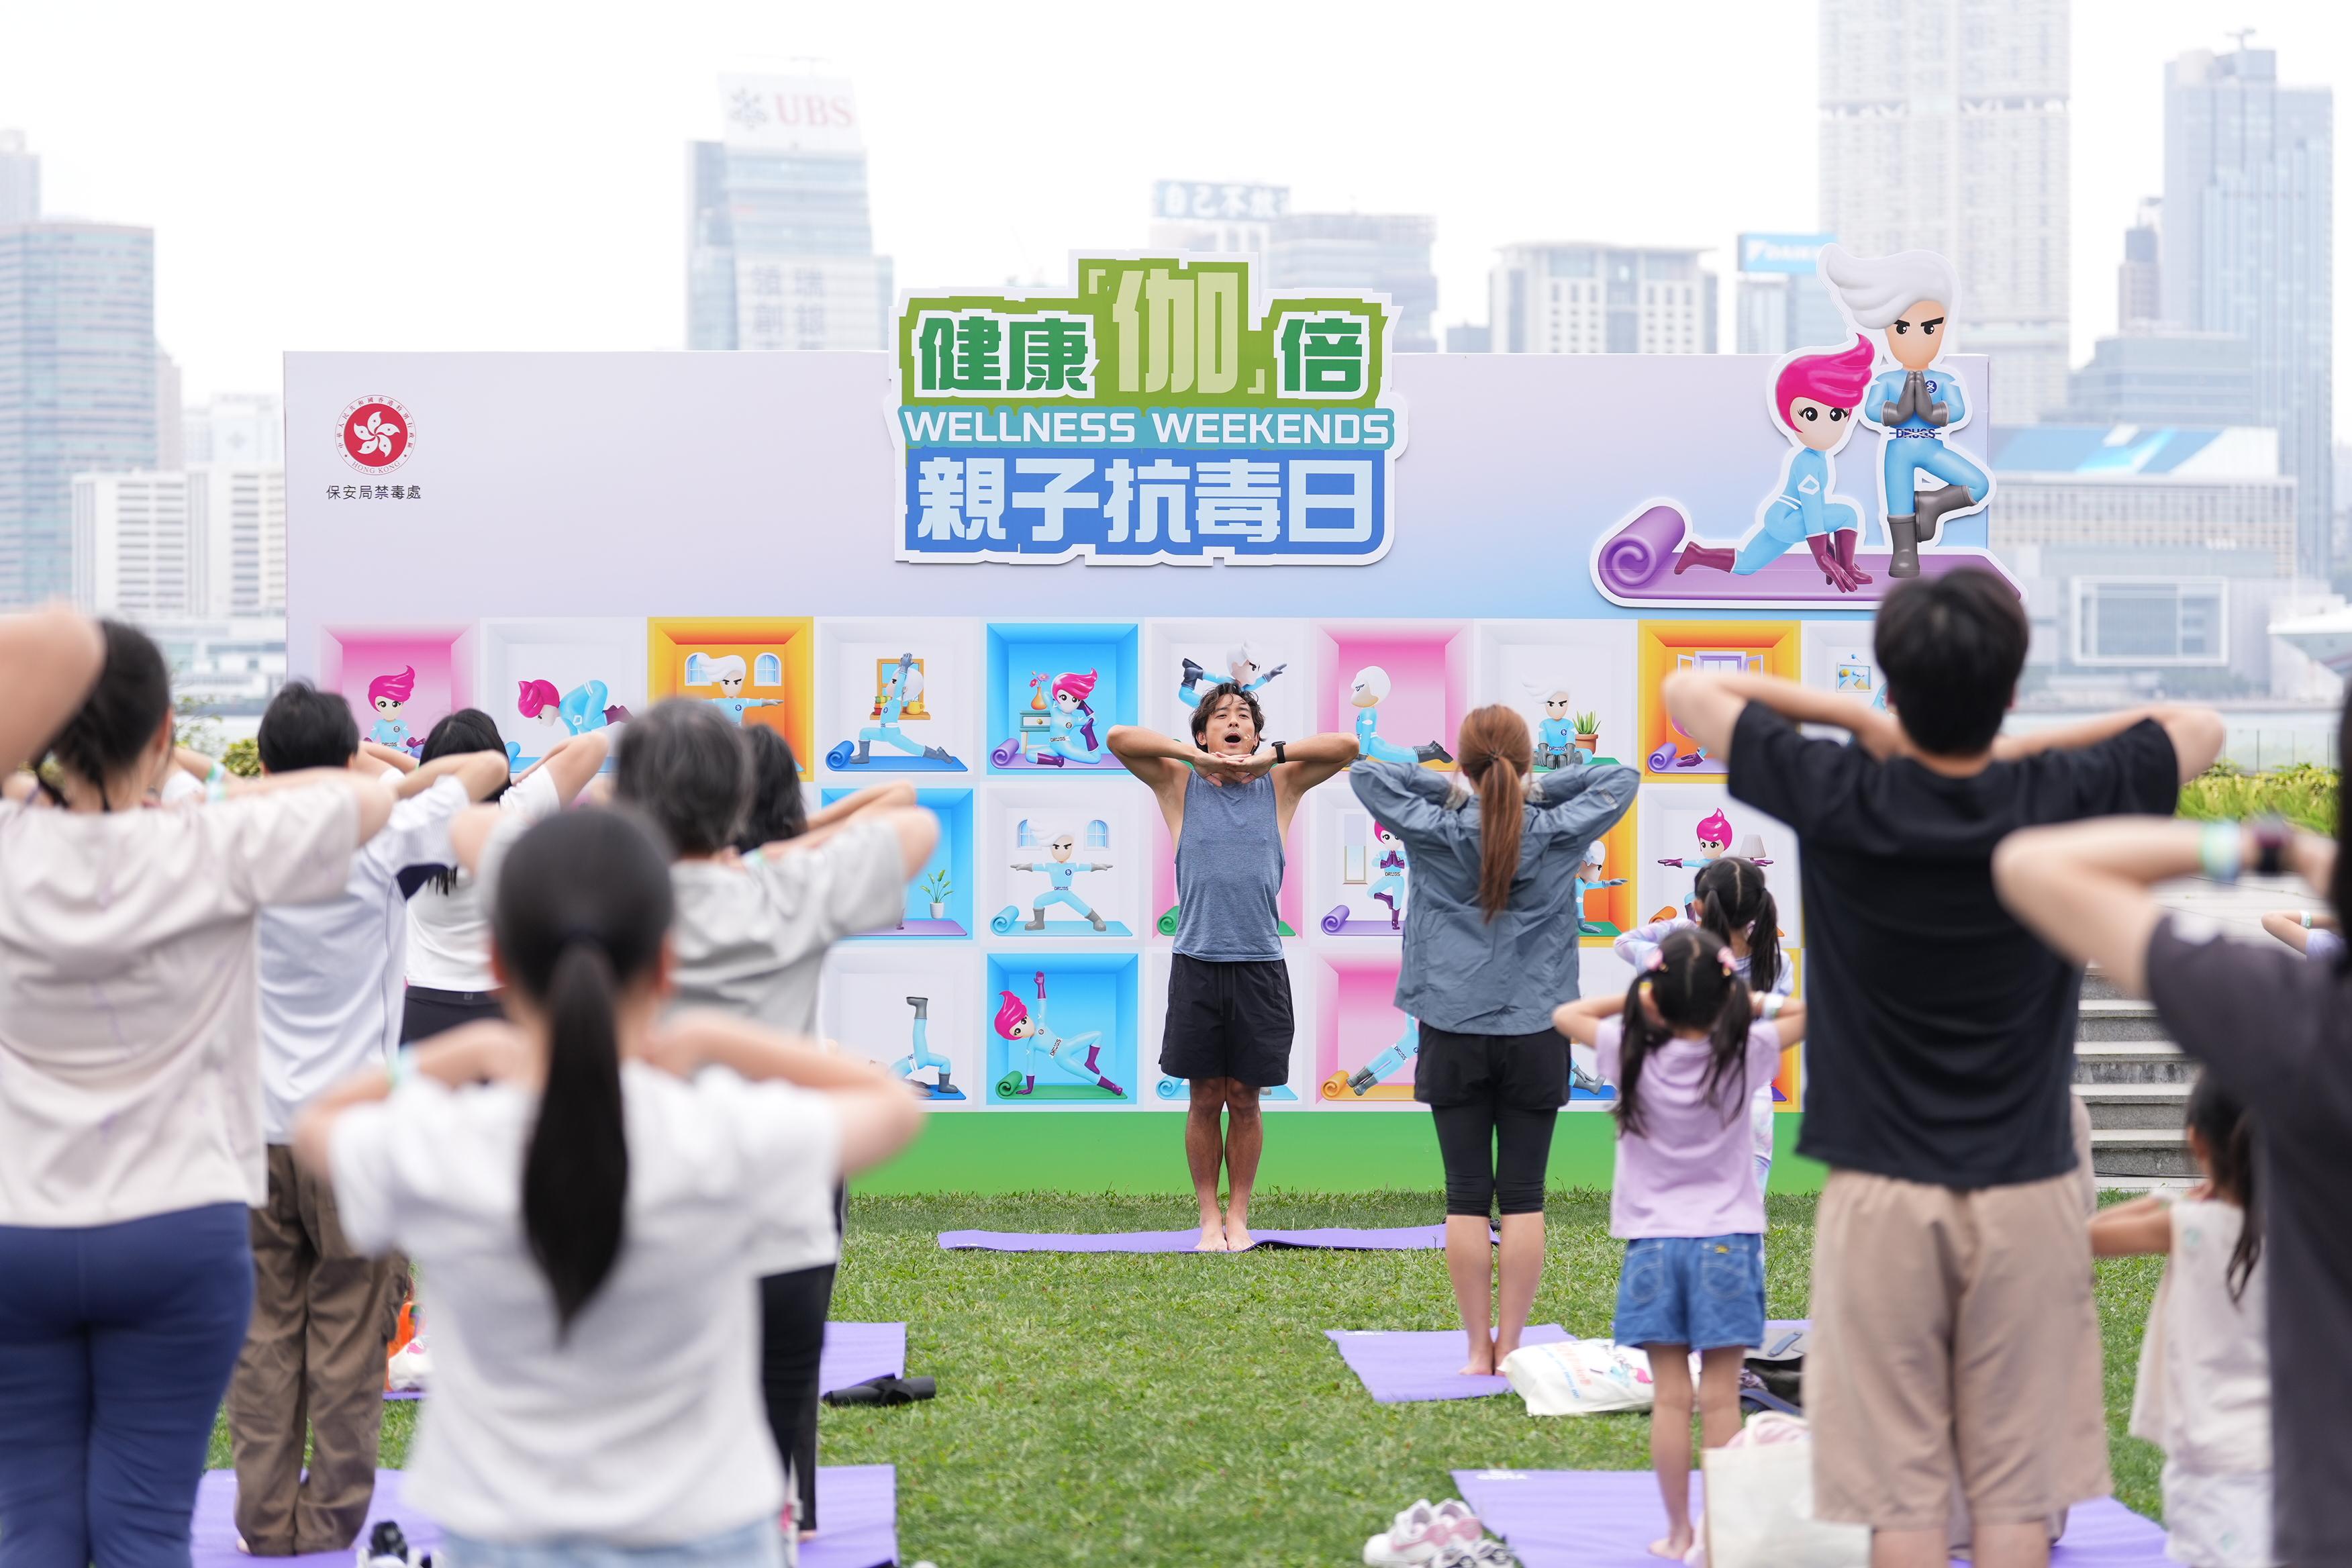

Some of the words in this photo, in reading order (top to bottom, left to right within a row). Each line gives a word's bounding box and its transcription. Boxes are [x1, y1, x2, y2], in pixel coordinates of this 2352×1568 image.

[904, 411, 1136, 443] WELLNESS
[1152, 412, 1389, 444] WEEKENDS
[351, 461, 376, 474] HONG
[378, 460, 401, 474] KONG
[326, 484, 422, 500] 保安局禁毒處
[918, 456, 1373, 543] 親子抗毒日
